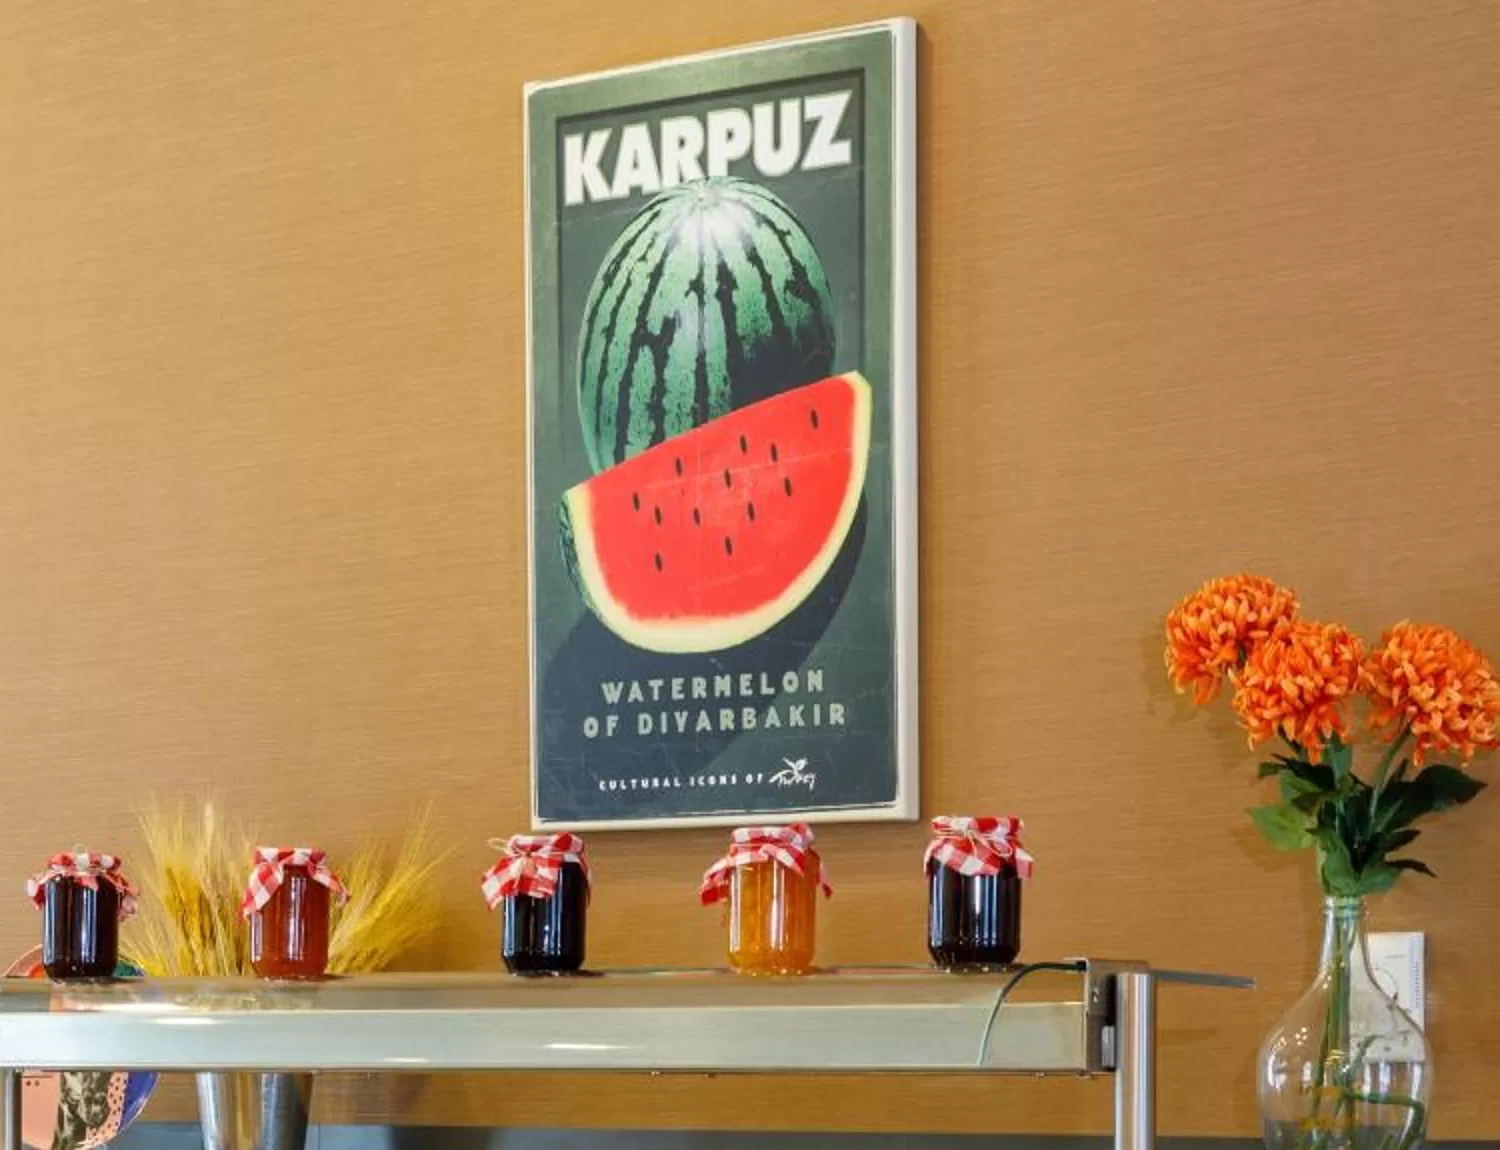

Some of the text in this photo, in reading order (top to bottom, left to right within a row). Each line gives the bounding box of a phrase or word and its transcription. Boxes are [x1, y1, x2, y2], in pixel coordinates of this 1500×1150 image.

[563, 89, 853, 207] KARPUZ
[601, 669, 824, 704] WATERMELON
[583, 703, 846, 739] OF DIYARBAKIR
[599, 776, 682, 792] CULTURAL
[689, 773, 737, 787] ICONS
[745, 773, 764, 785] OF
